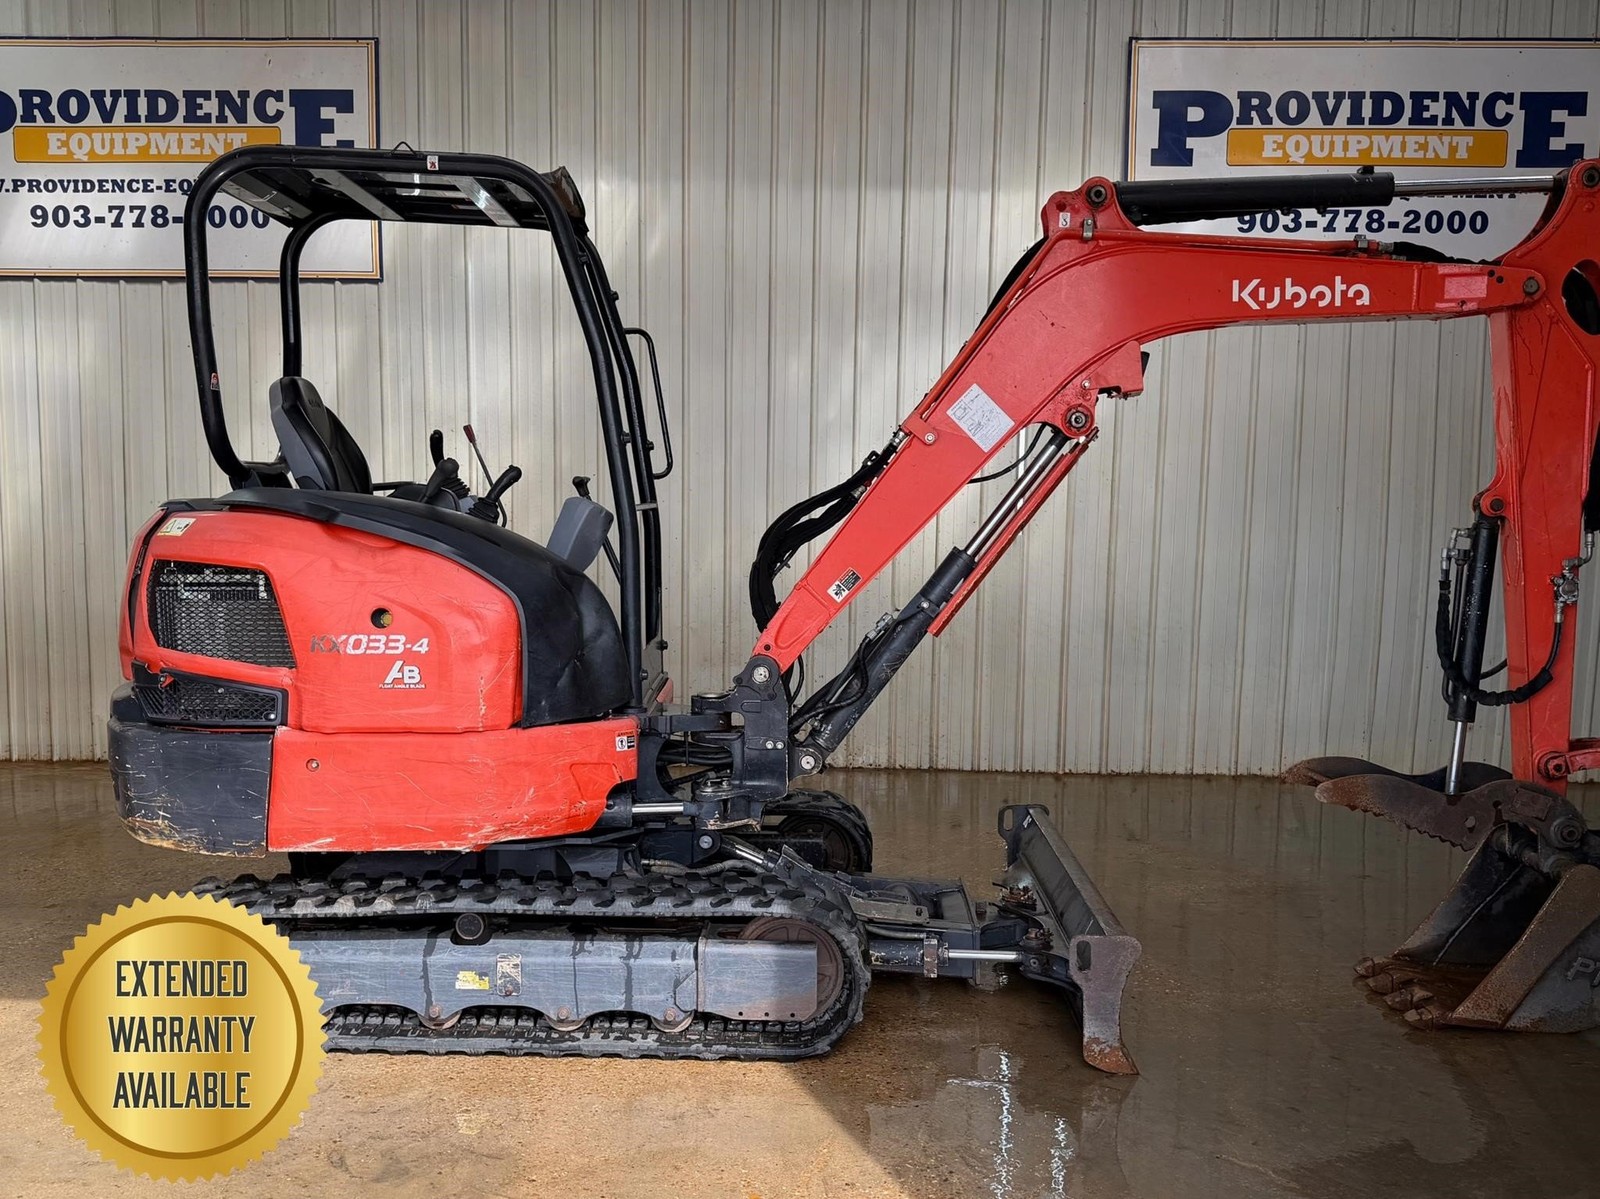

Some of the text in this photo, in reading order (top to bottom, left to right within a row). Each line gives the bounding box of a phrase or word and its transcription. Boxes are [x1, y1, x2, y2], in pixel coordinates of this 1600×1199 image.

[0, 88, 354, 148] ROVIDENCE
[1151, 90, 1588, 168] PROVIDENCE
[46, 132, 248, 158] EQUIPMENT
[1262, 134, 1474, 164] EQUIPMENT
[0, 179, 194, 196] .PROVIDENCE-EQ
[30, 204, 270, 228] 903-778-000
[1237, 209, 1489, 234] 903-778-2000
[1232, 275, 1370, 310] Kubota
[310, 634, 429, 654] KX033-4
